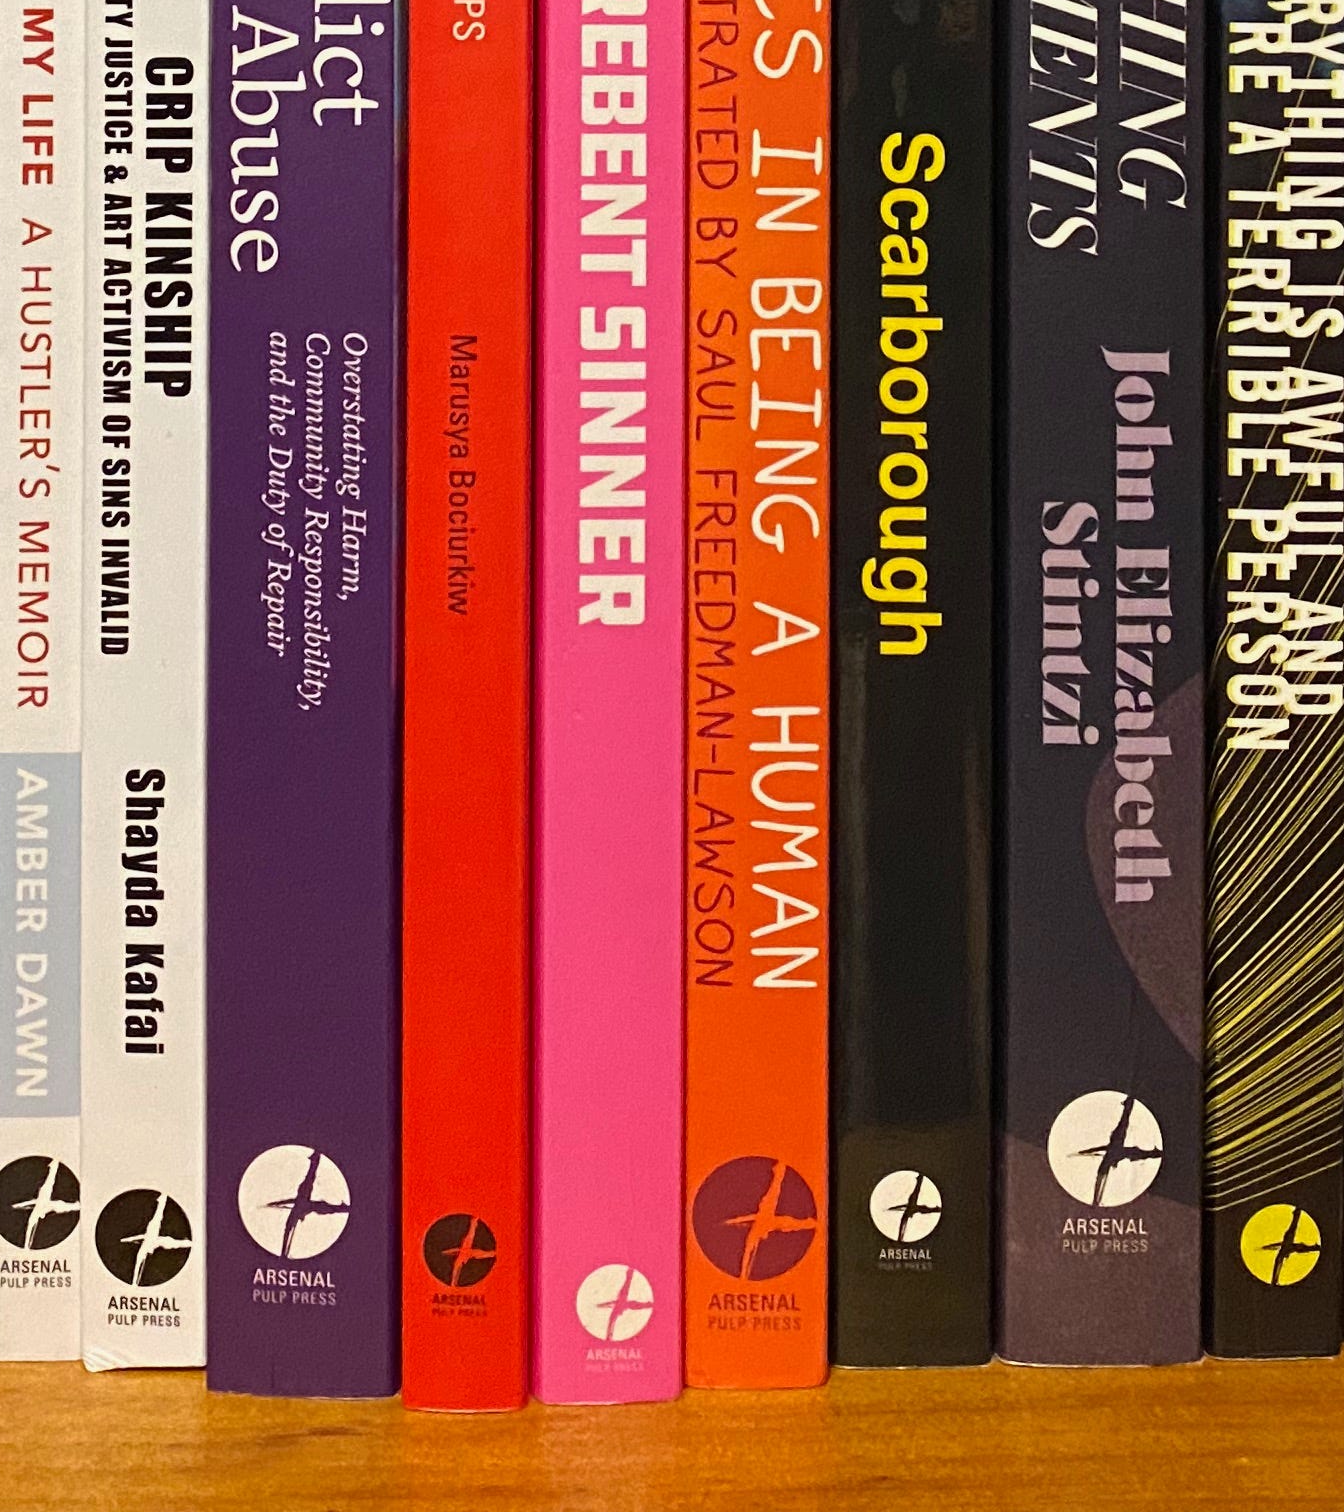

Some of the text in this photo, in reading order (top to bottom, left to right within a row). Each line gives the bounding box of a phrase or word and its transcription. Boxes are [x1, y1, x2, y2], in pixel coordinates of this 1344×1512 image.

[20, 7, 55, 76] MY
[20, 94, 55, 187] LIFE
[228, 5, 303, 272] Abuse
[144, 56, 193, 398] CRIP KINSHIP
[750, 130, 824, 232] IN
[16, 219, 55, 709] A HUSTLER'S MEMOIR
[260, 332, 295, 657] and the Duty of Repair
[296, 332, 333, 711] Community Responsibility,
[336, 332, 367, 602] Overstating Harm,
[443, 335, 480, 458] Marusya
[579, 304, 648, 627] SINNER
[750, 278, 824, 547] BEING
[861, 132, 945, 658] Scarborough
[749, 602, 820, 656] A
[1039, 502, 1097, 744] Stintzi
[1103, 346, 1171, 902] John Elizabeth
[118, 768, 166, 1057] Shayda Kafai
[749, 704, 820, 992] HUMAN
[253, 1268, 335, 1288] ARSENAL
[253, 1290, 337, 1306] PULP PRESS
